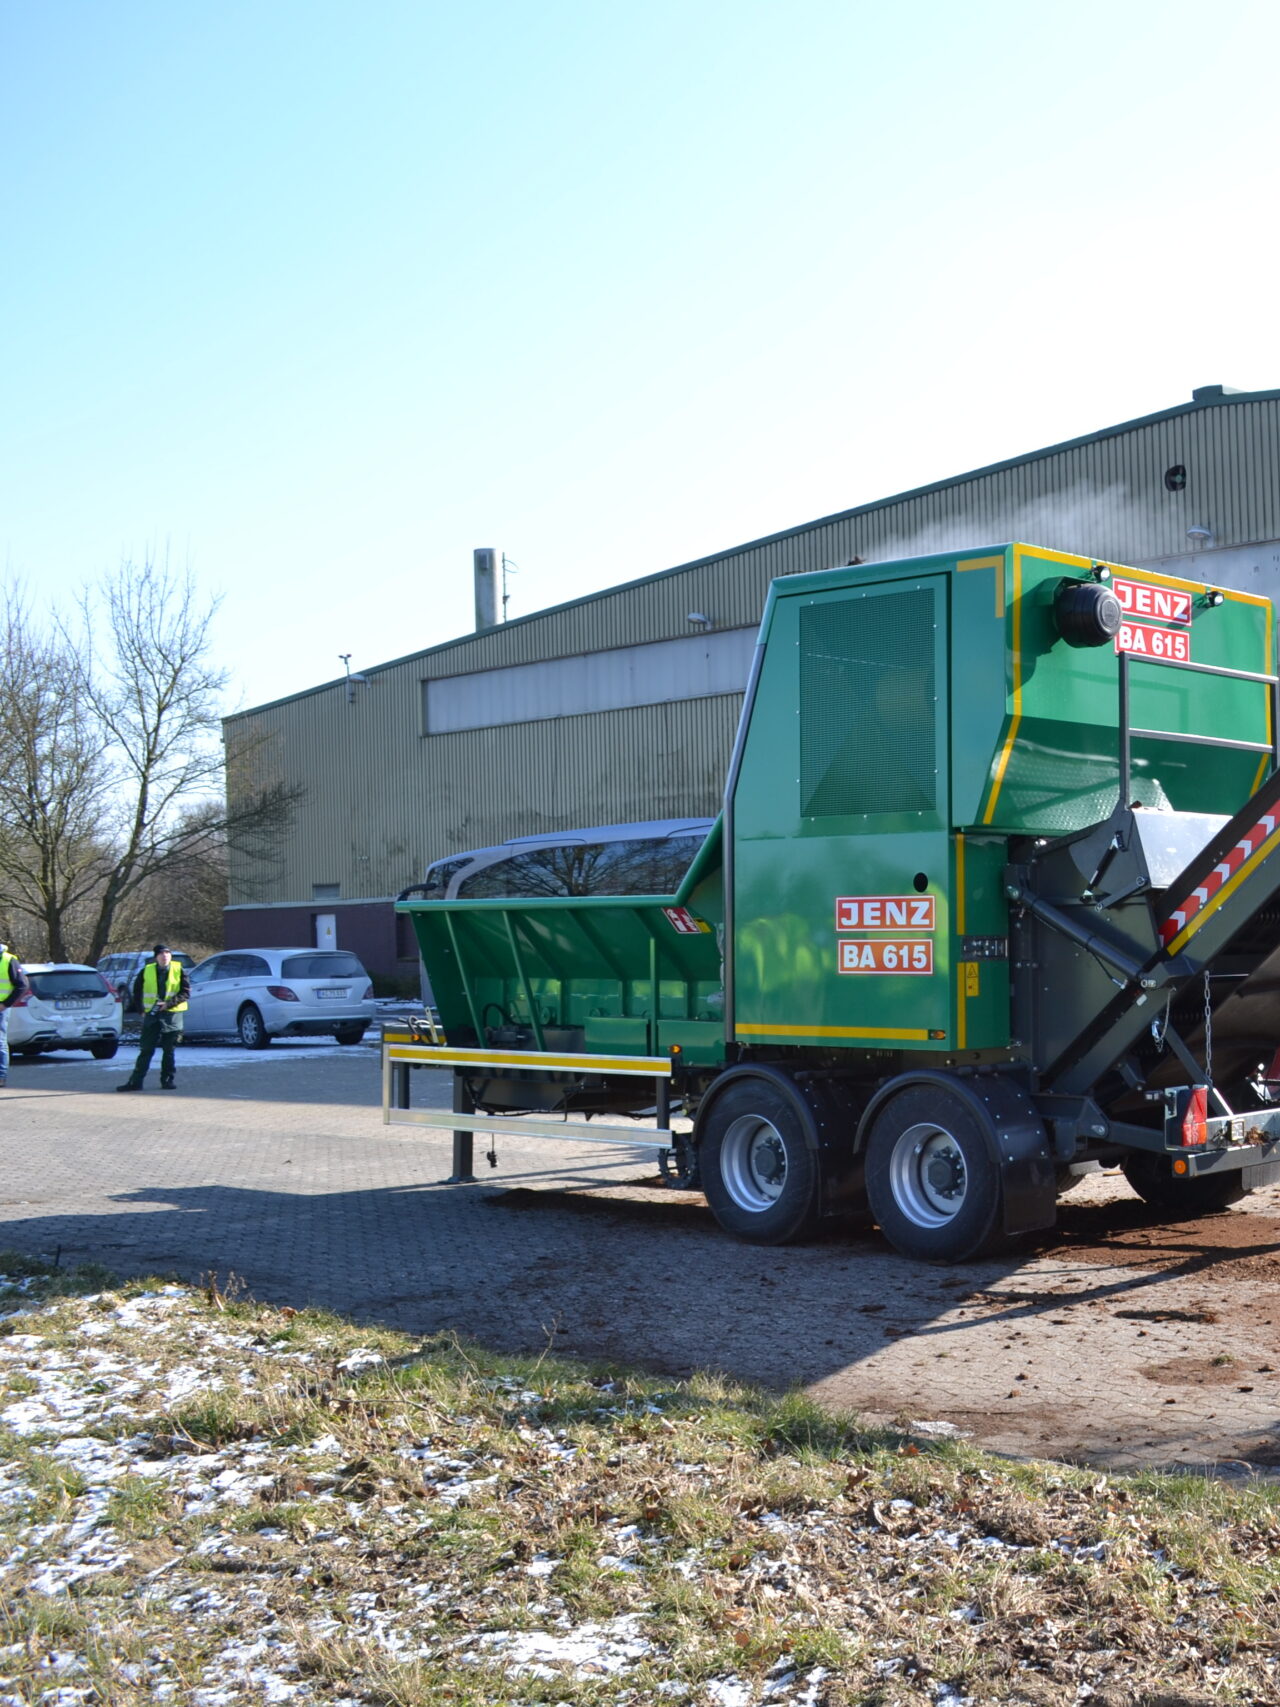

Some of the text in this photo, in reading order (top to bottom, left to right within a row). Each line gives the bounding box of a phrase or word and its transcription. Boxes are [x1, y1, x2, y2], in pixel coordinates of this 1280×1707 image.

[1117, 584, 1188, 620] JENZ
[1119, 626, 1186, 659] BA 615
[840, 901, 930, 926] JENZ
[843, 944, 927, 969] BA 615
